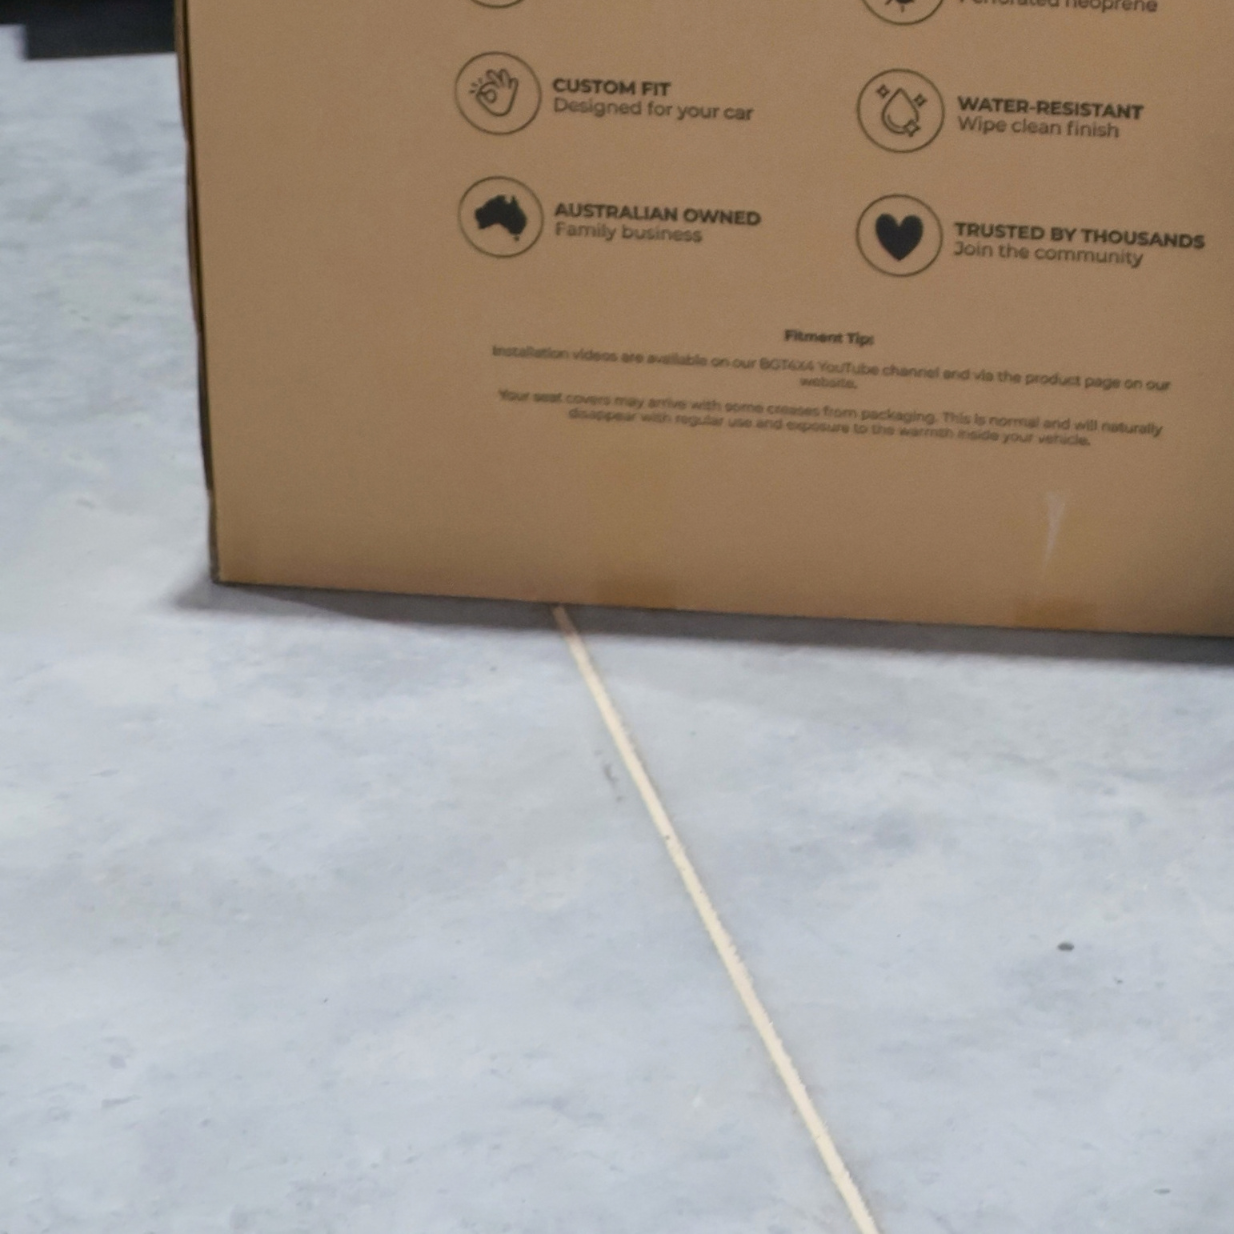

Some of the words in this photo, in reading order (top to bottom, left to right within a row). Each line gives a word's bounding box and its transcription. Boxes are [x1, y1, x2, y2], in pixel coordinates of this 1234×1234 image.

[551, 78, 637, 95] CUSTOM
[641, 80, 672, 96] FIT
[554, 98, 642, 118] Designed
[647, 100, 674, 117] for
[677, 106, 720, 122] your
[723, 108, 754, 121] car
[957, 95, 1144, 120] WATER-RESISTANT
[957, 116, 1006, 137] Wipe
[1011, 119, 1062, 136] clean
[1066, 118, 1120, 139] finish
[553, 203, 678, 222] AUSTRALIAN
[682, 207, 763, 228] OWNED
[554, 222, 616, 243] Family
[621, 225, 704, 244] business
[953, 221, 1046, 241] TRUSTED
[1050, 226, 1078, 243] BY
[1080, 229, 1206, 249] THOUSANDS
[953, 241, 994, 258] Join
[998, 244, 1031, 260] the
[1034, 246, 1144, 268] community
[784, 329, 843, 344] Fitment
[492, 344, 570, 359] Installation
[572, 348, 618, 362] videos
[621, 353, 644, 363] are
[711, 357, 730, 367] on
[732, 358, 757, 369] our
[818, 360, 880, 375] YouTube
[882, 364, 940, 378] channel
[943, 367, 970, 379] and
[973, 368, 994, 381] via
[997, 369, 1022, 382] the
[1025, 371, 1082, 387] product
[1084, 376, 1121, 389] page
[1124, 378, 1142, 388] on
[1146, 379, 1172, 390] our
[498, 388, 530, 401] Your
[566, 394, 610, 406] covers
[614, 397, 644, 410] may
[648, 396, 687, 410] arrive
[691, 399, 722, 412] with
[725, 403, 764, 414] some
[823, 406, 857, 419] from
[943, 412, 971, 425] This
[974, 414, 986, 426] is
[989, 415, 1040, 429] normal
[1043, 417, 1070, 430] and
[1074, 419, 1098, 432] will
[1101, 421, 1164, 438] naturally
[641, 409, 672, 422] with
[676, 411, 724, 427] regular
[728, 416, 752, 426] use
[756, 415, 782, 428] and
[786, 419, 850, 434] exposure
[854, 420, 868, 432] to
[872, 421, 896, 434] the
[957, 426, 1000, 439] inside
[1002, 430, 1034, 444] your
